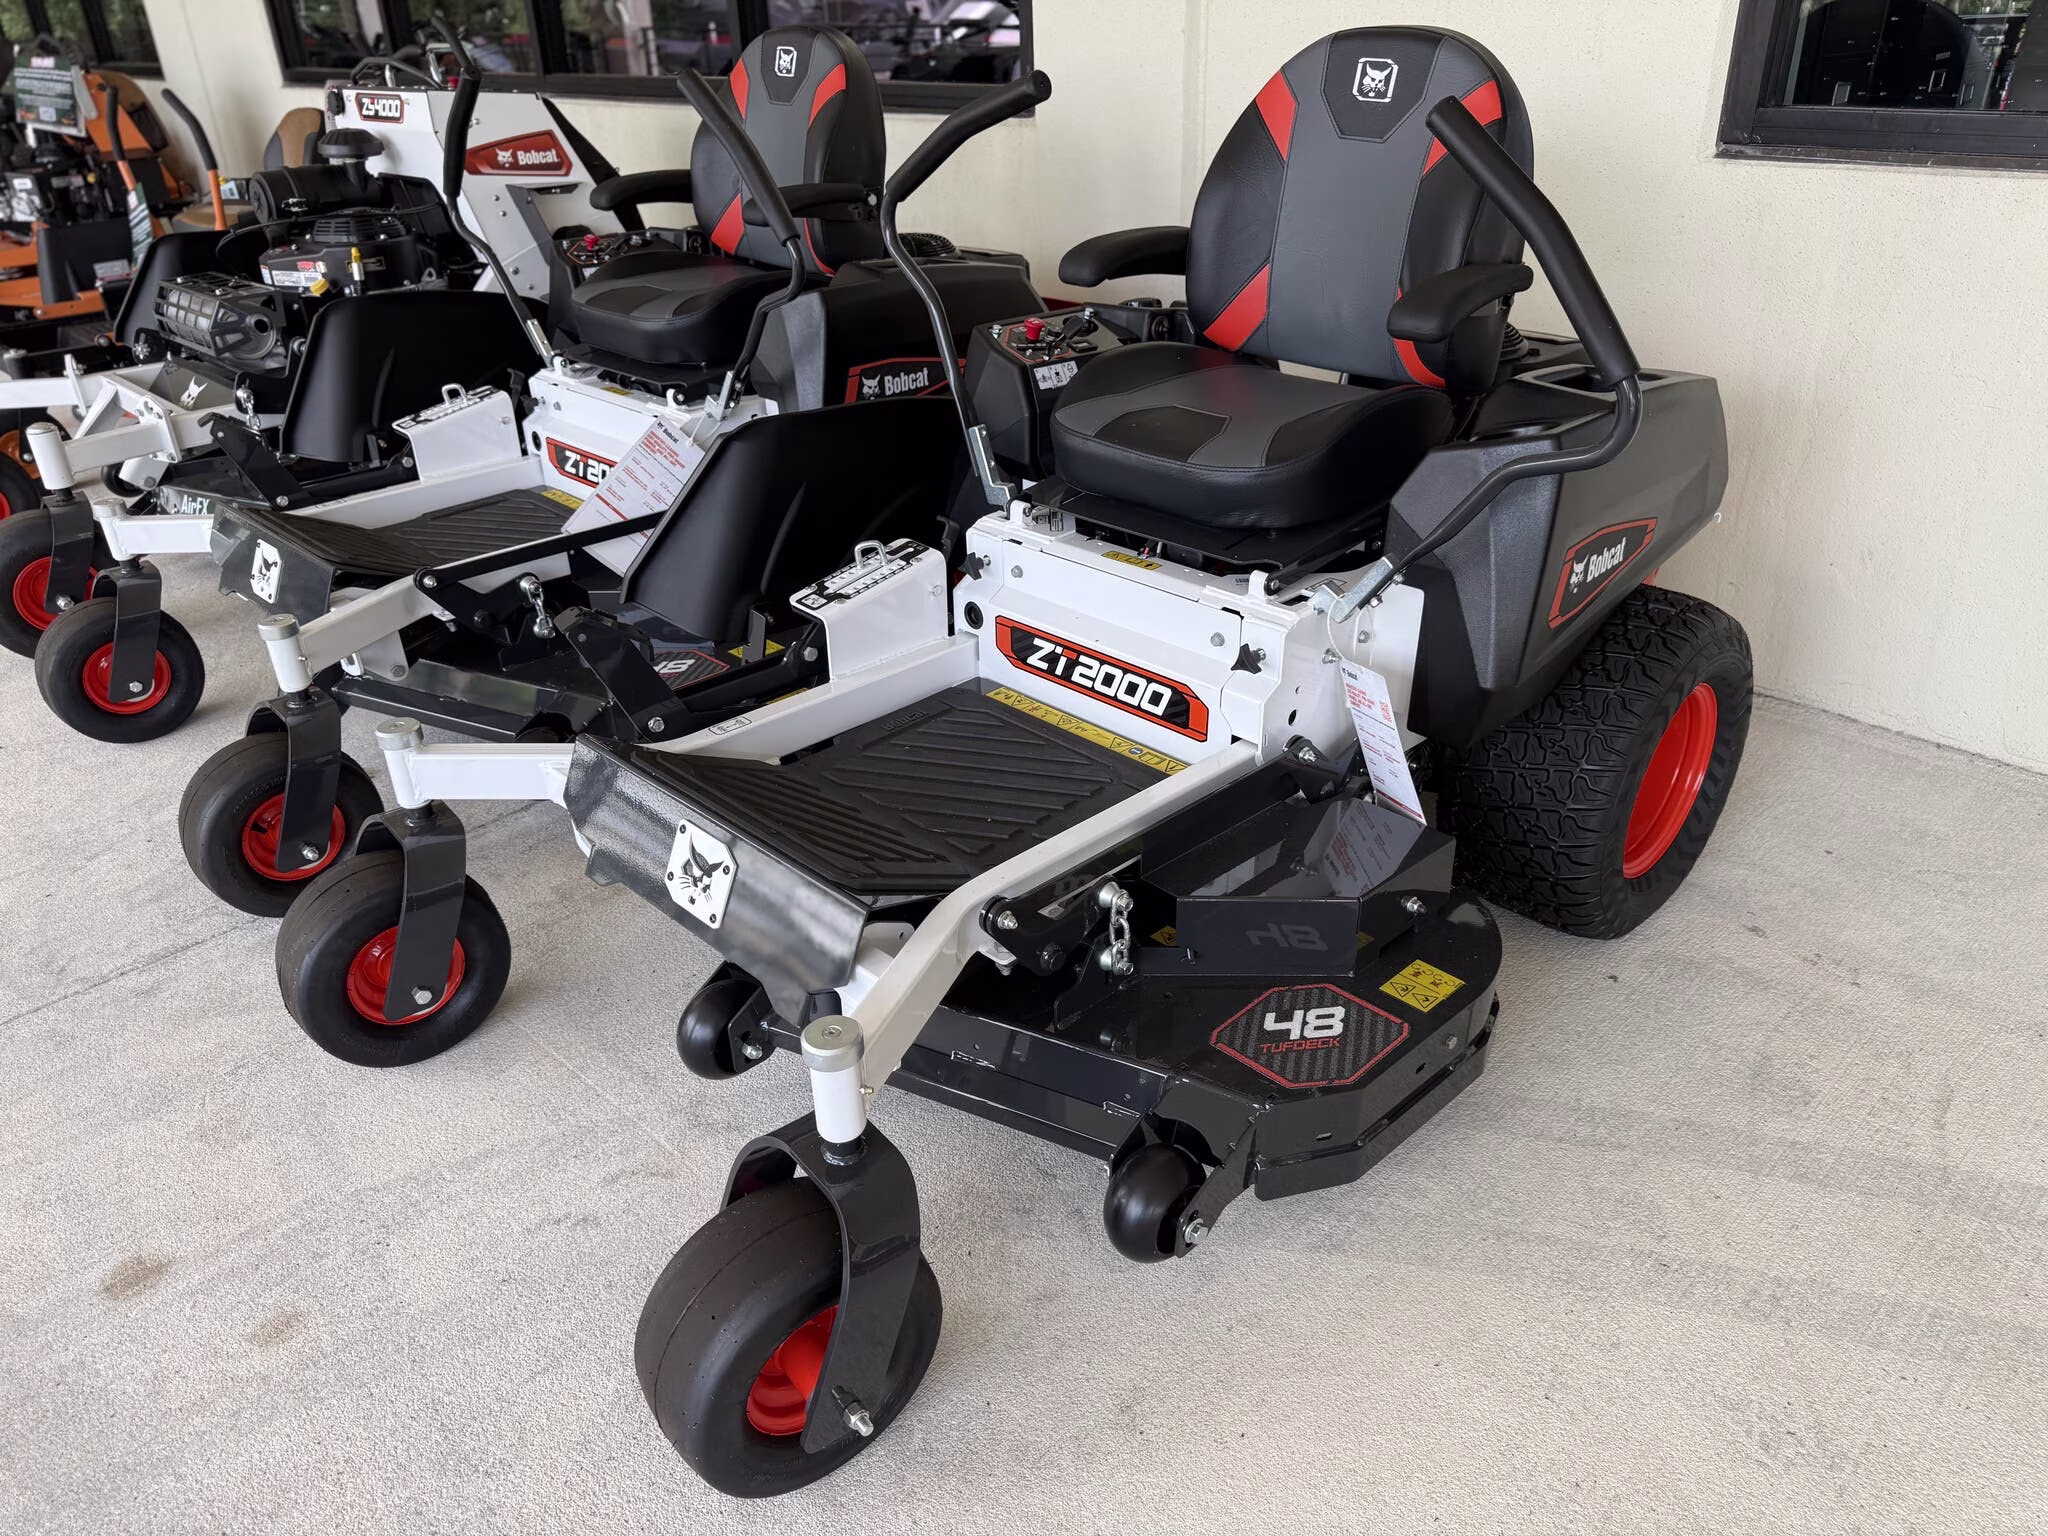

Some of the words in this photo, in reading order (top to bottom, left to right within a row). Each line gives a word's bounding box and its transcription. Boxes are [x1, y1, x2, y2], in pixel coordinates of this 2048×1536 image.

[361, 98, 400, 118] ZS4000
[517, 149, 558, 165] Bobcat
[884, 367, 929, 396] Bobcat
[564, 449, 616, 484] ZT20
[181, 494, 210, 515] AirFX
[1586, 537, 1627, 583] Bobcat
[1026, 637, 1172, 716] ZT2000
[1263, 1005, 1346, 1040] 48
[1260, 1037, 1342, 1053] TUFDECK
